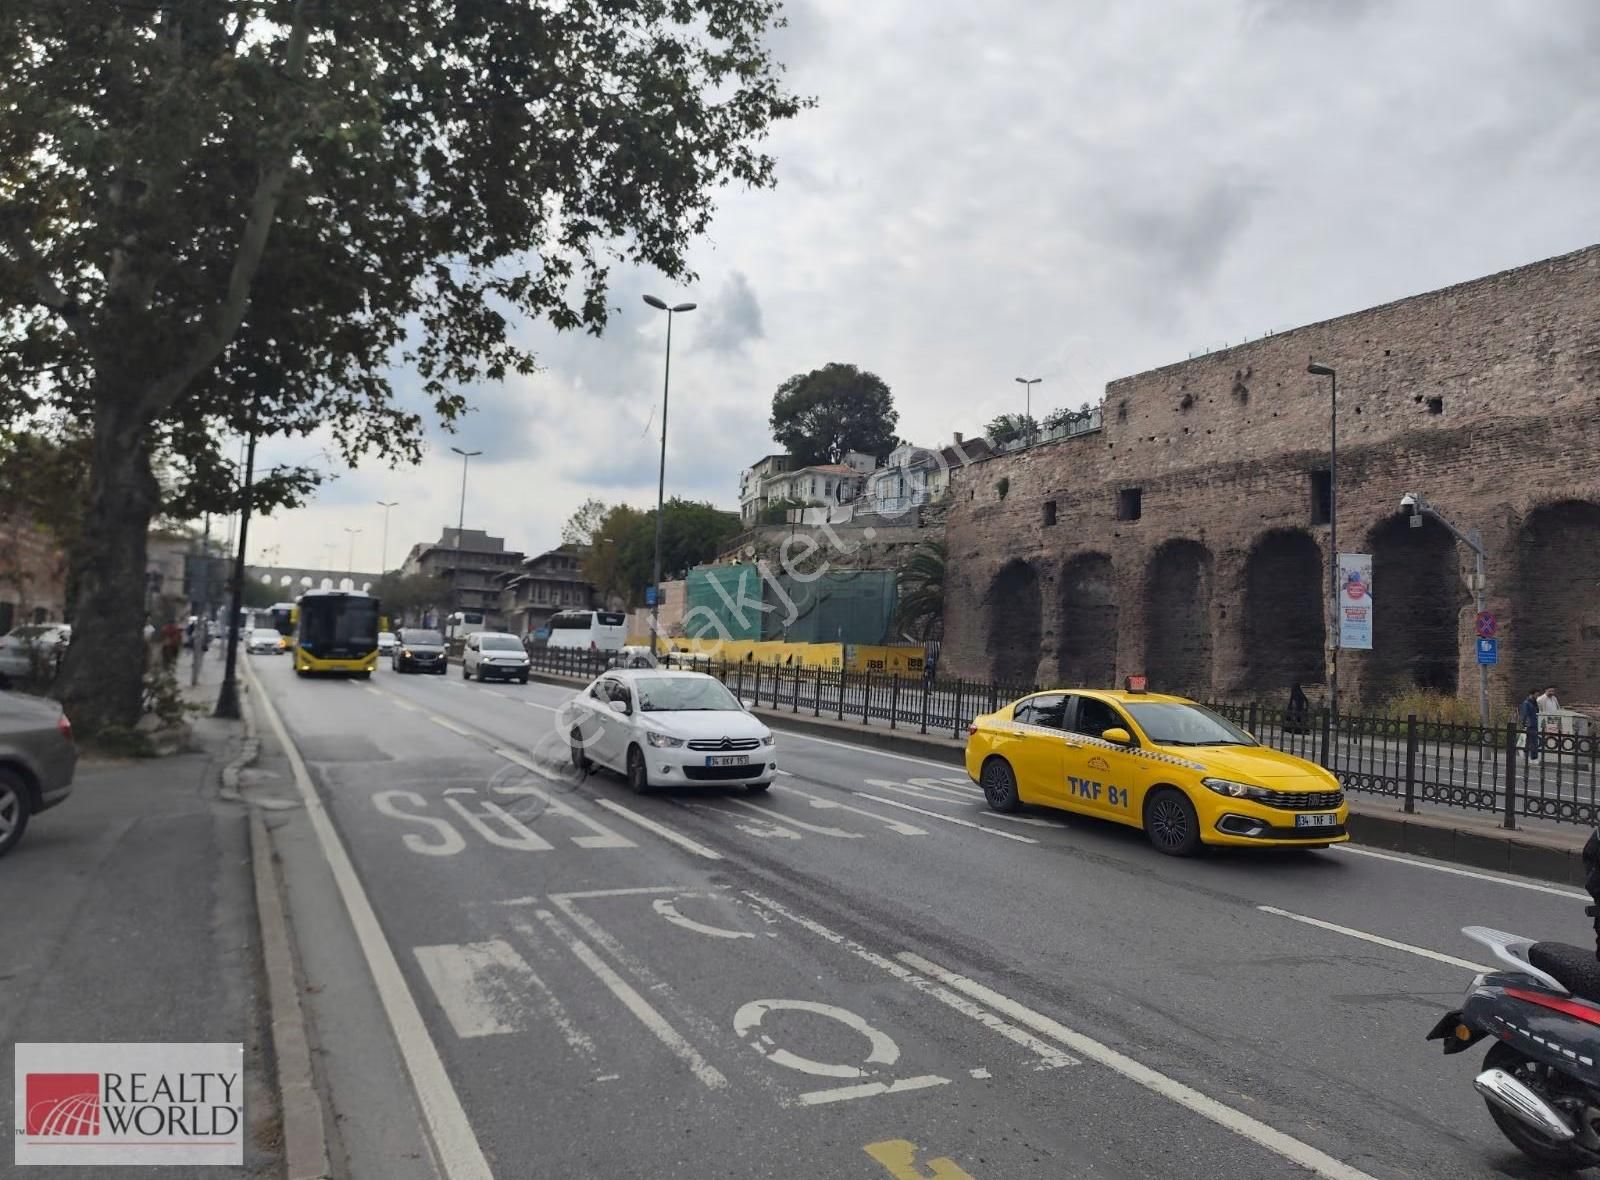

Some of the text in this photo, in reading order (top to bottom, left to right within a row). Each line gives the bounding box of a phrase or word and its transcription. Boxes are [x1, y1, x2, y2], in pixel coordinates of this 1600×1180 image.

[1067, 775, 1129, 809] TKF 81
[1301, 815, 1309, 825] 34
[1312, 815, 1324, 825] TKF
